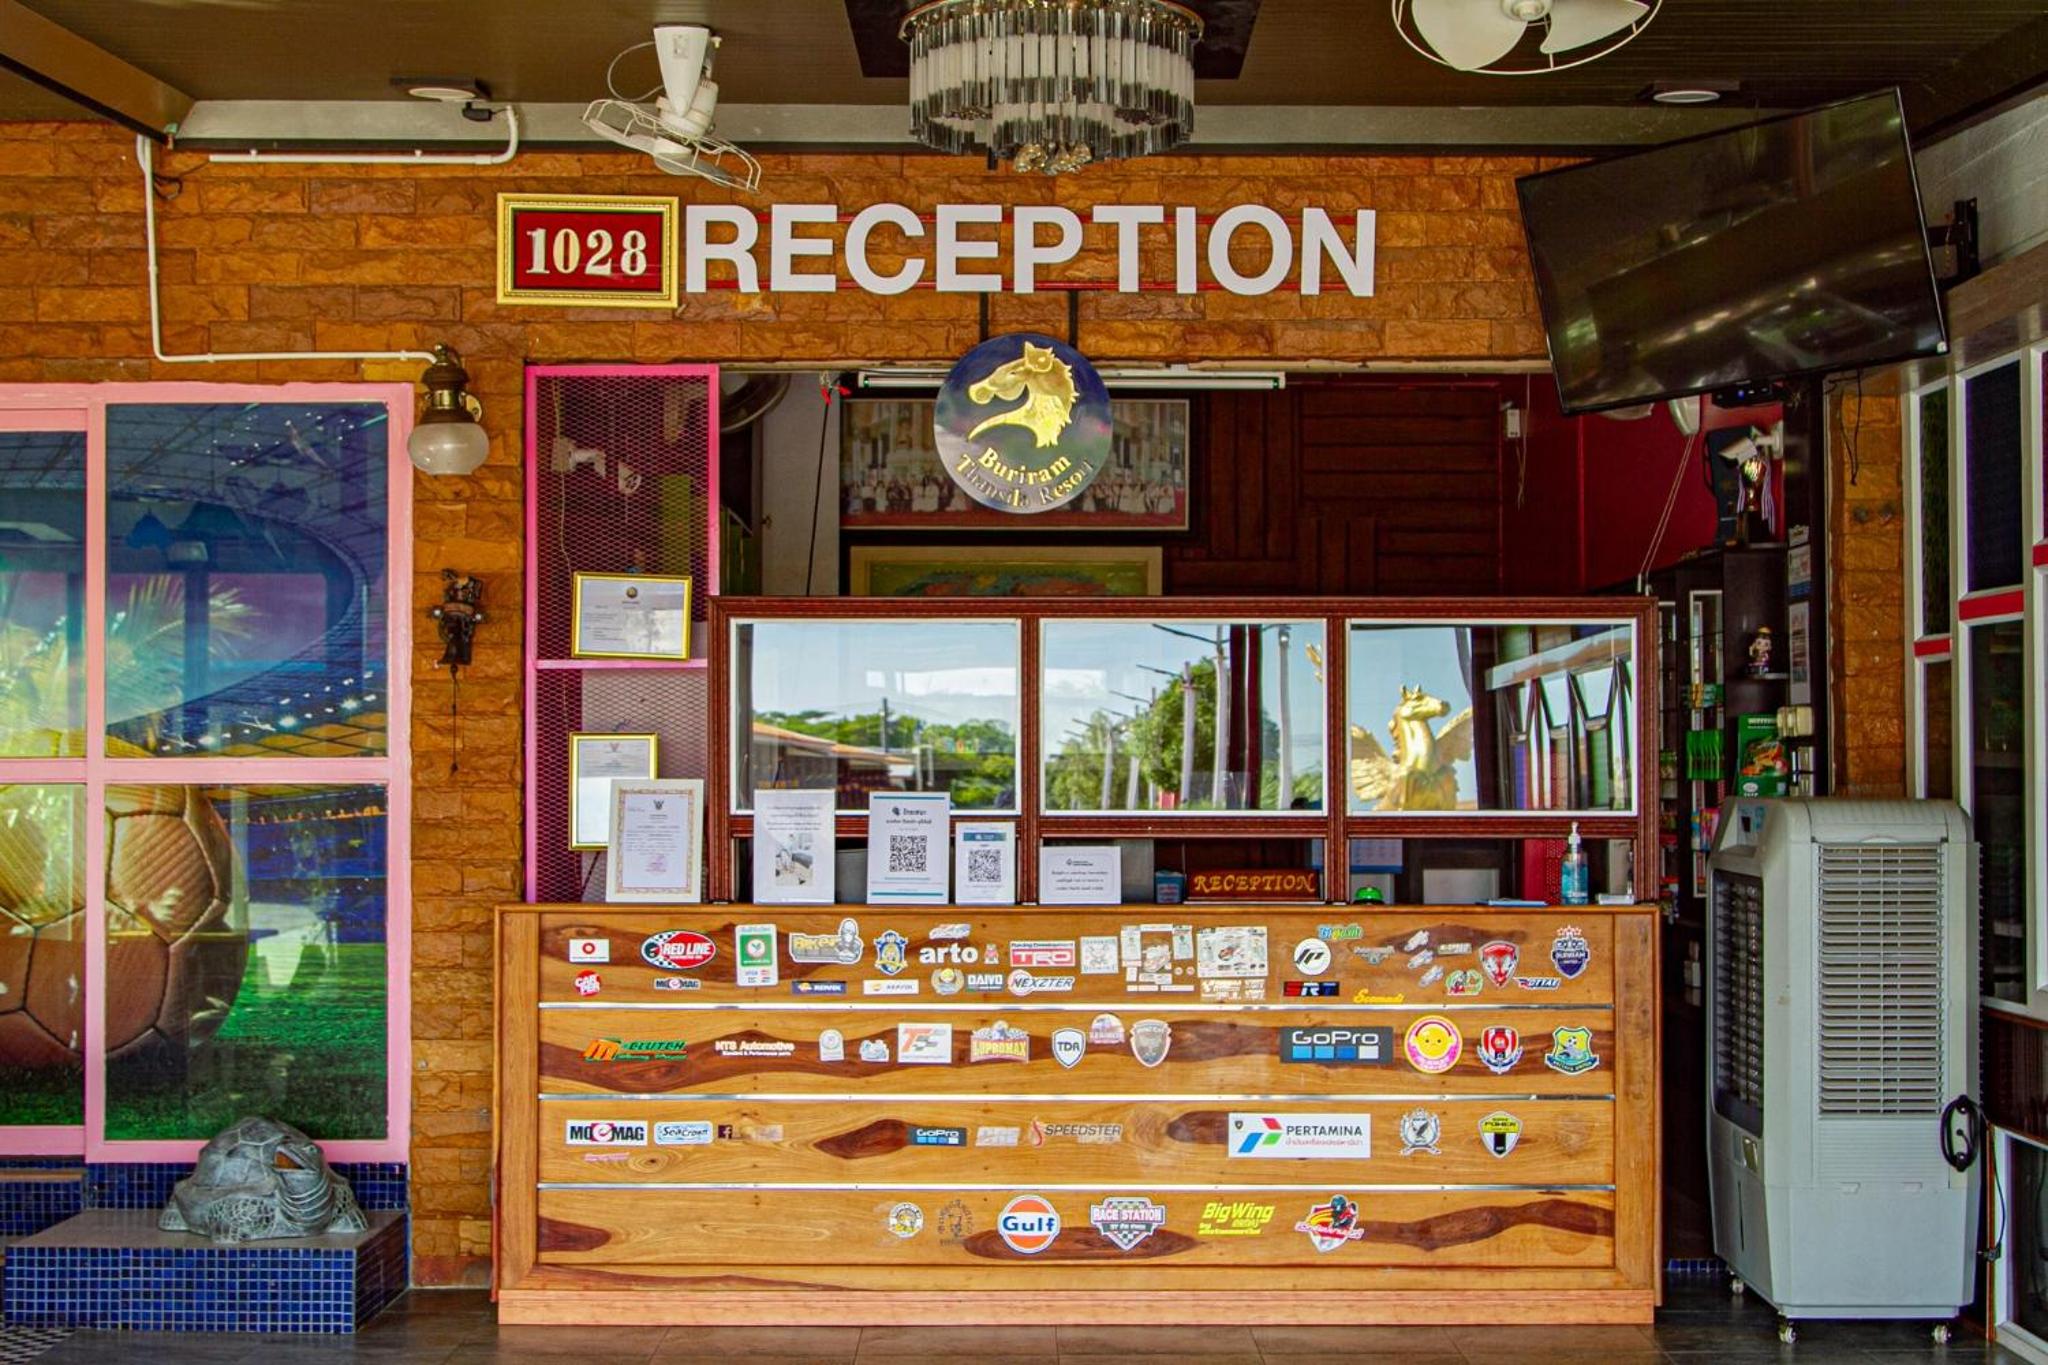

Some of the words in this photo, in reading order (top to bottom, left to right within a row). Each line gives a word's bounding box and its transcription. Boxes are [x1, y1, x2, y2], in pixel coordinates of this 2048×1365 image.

[526, 228, 647, 276] 1028
[686, 204, 1376, 297] RECEPTION
[978, 447, 1072, 485] Buriram
[1194, 873, 1316, 893] RECEPTION
[920, 943, 978, 963] arto
[1292, 1031, 1379, 1045] GoPro
[917, 1129, 959, 1137] GoPro
[1045, 1125, 1121, 1136] SPEEDSTER
[1286, 1126, 1363, 1136] PERTAMINA
[1093, 1209, 1119, 1221] RACE
[1121, 1209, 1162, 1221] STATION
[1002, 1216, 1056, 1232] Gulf
